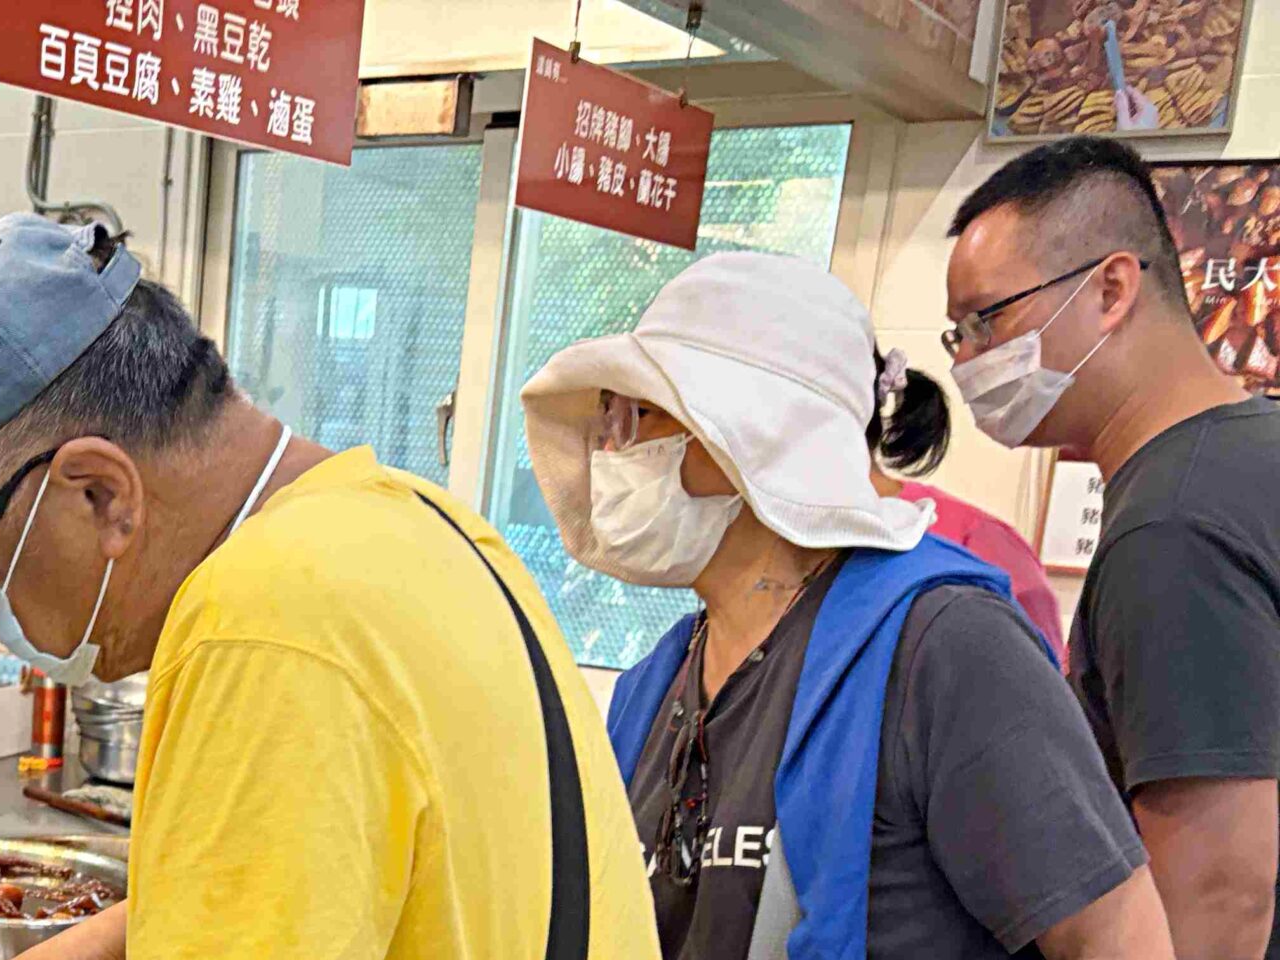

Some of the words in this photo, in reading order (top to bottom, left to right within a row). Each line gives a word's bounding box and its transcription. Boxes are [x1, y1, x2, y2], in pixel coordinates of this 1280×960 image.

[39, 23, 316, 145] 百頁豆腐、素雞、滷蛋
